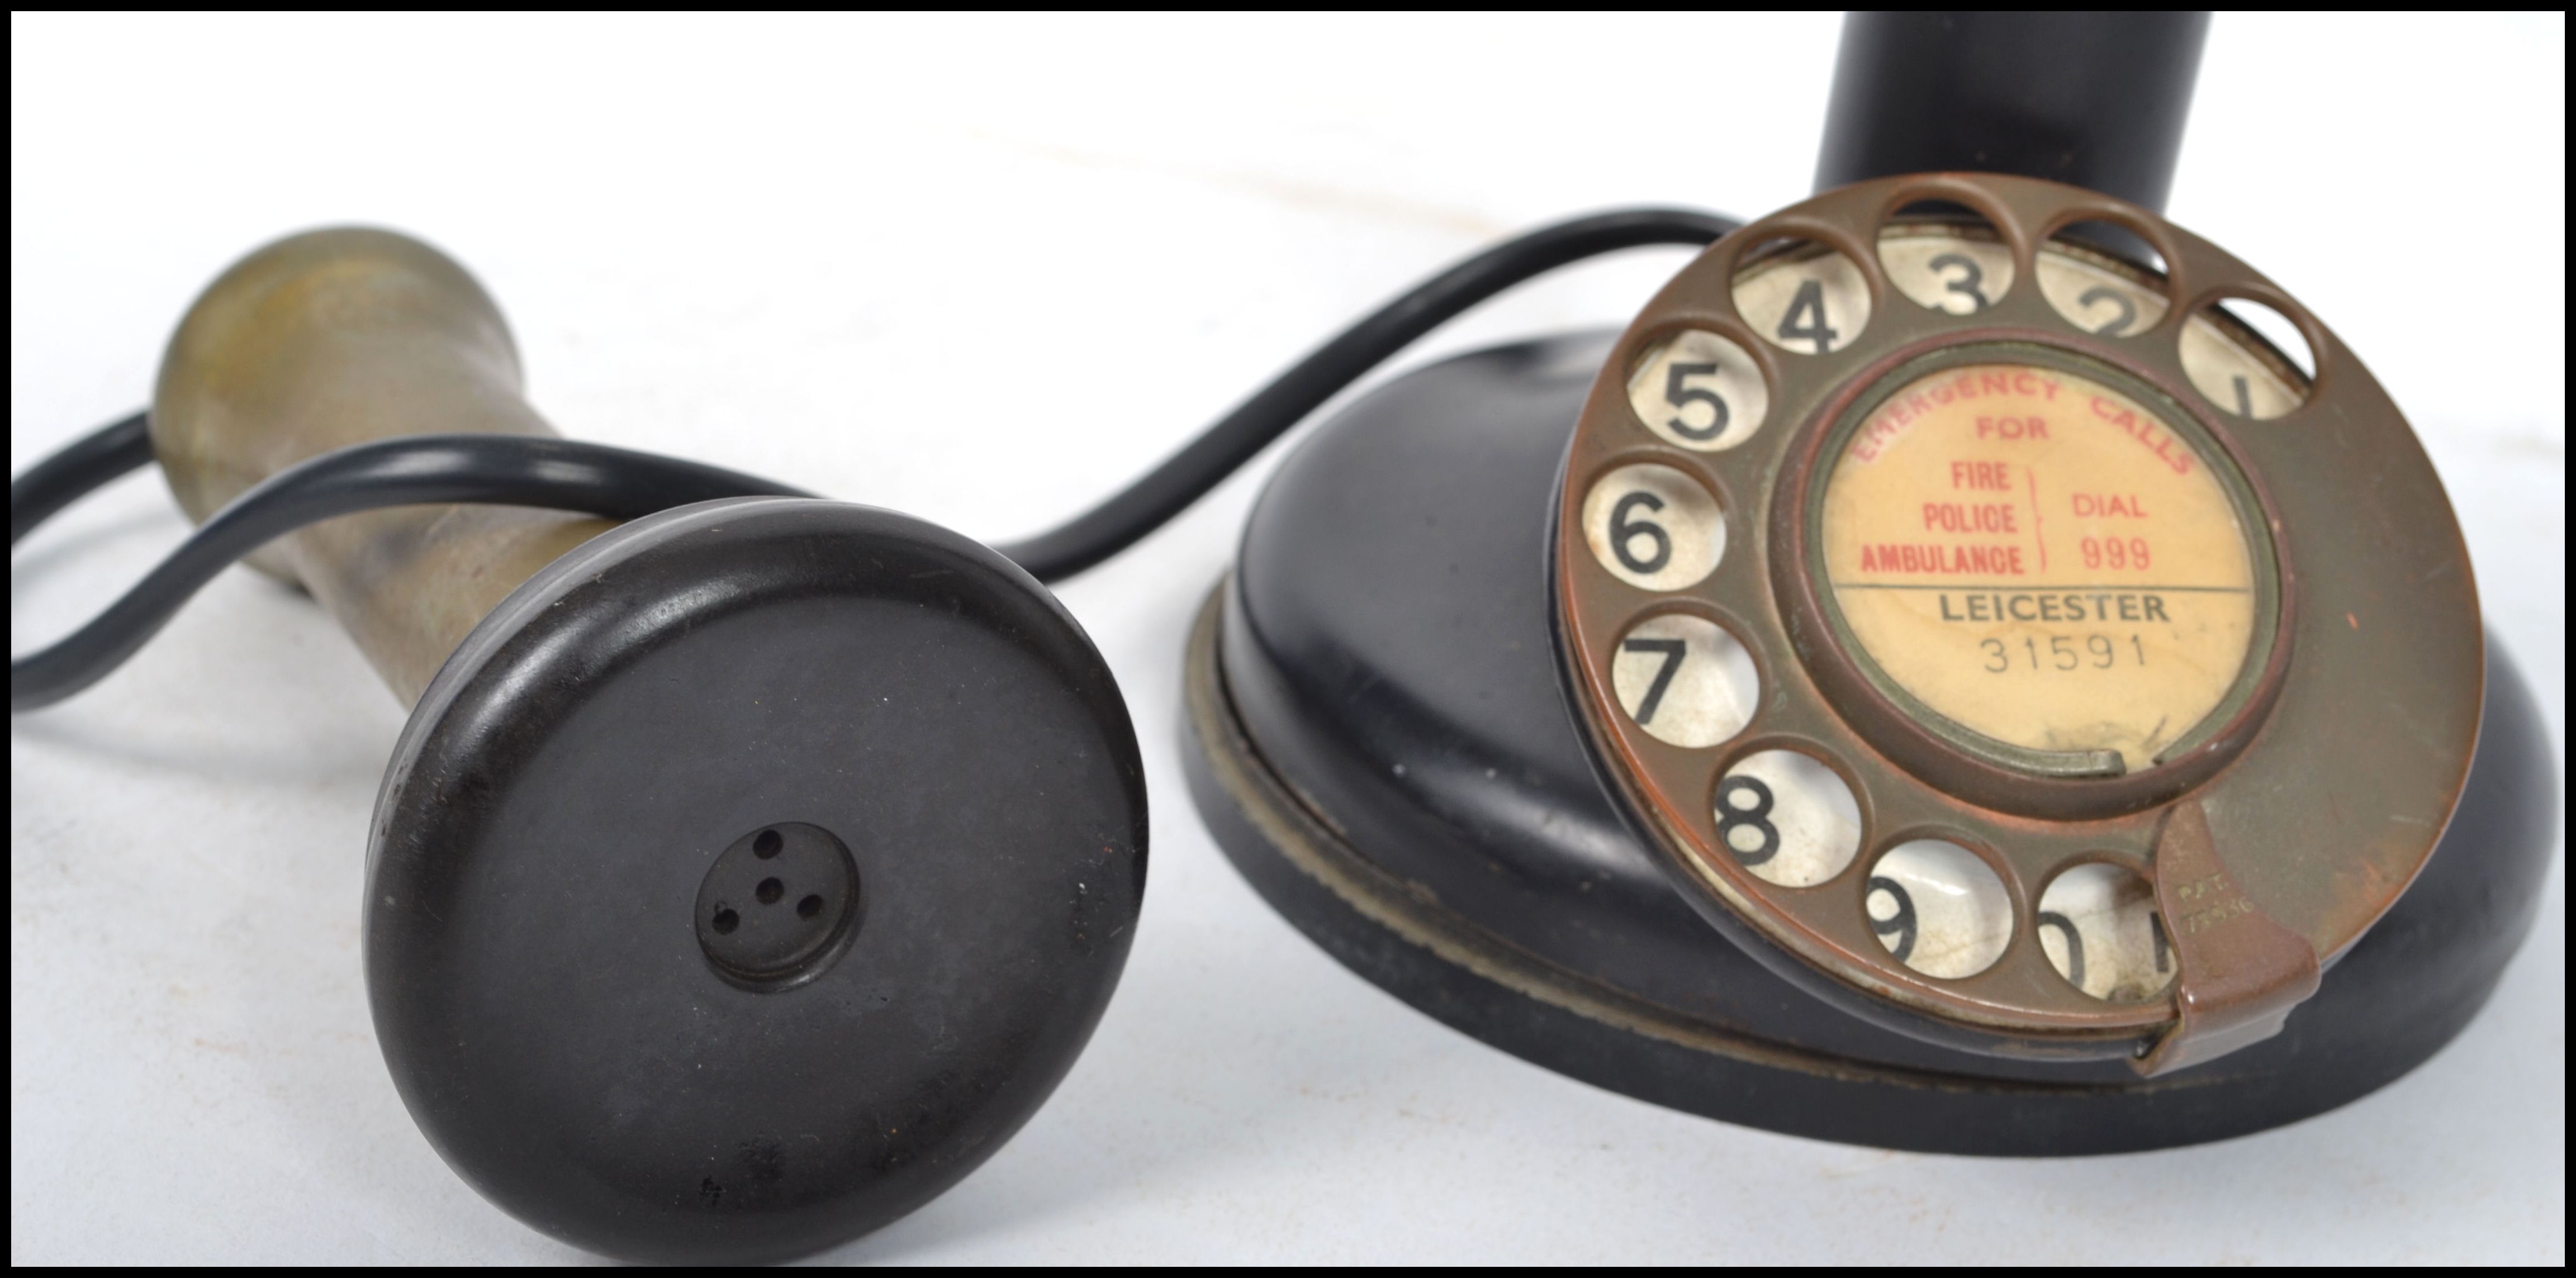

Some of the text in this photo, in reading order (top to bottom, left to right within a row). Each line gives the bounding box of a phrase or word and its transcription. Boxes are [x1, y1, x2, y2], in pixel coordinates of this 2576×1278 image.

[1927, 250, 1990, 309] 3
[1777, 279, 1838, 353] 4
[2078, 286, 2136, 335] 2
[1664, 363, 1729, 441] 5
[1852, 369, 2195, 476] EMERGENCY CALLS
[1975, 416, 2050, 440] FOR
[1951, 461, 2012, 491] FIRE
[1922, 503, 2018, 533] POLICE
[2072, 493, 2148, 518] DIAL
[1609, 492, 1673, 575] 6
[2080, 537, 2152, 570] 999
[1861, 544, 2025, 575] AMBULANCE
[1939, 593, 2170, 623] LEICESTER
[1979, 634, 2147, 672] 31591
[1623, 638, 1687, 725] 7
[1716, 775, 1780, 866] 8
[1866, 875, 1918, 965] 9
